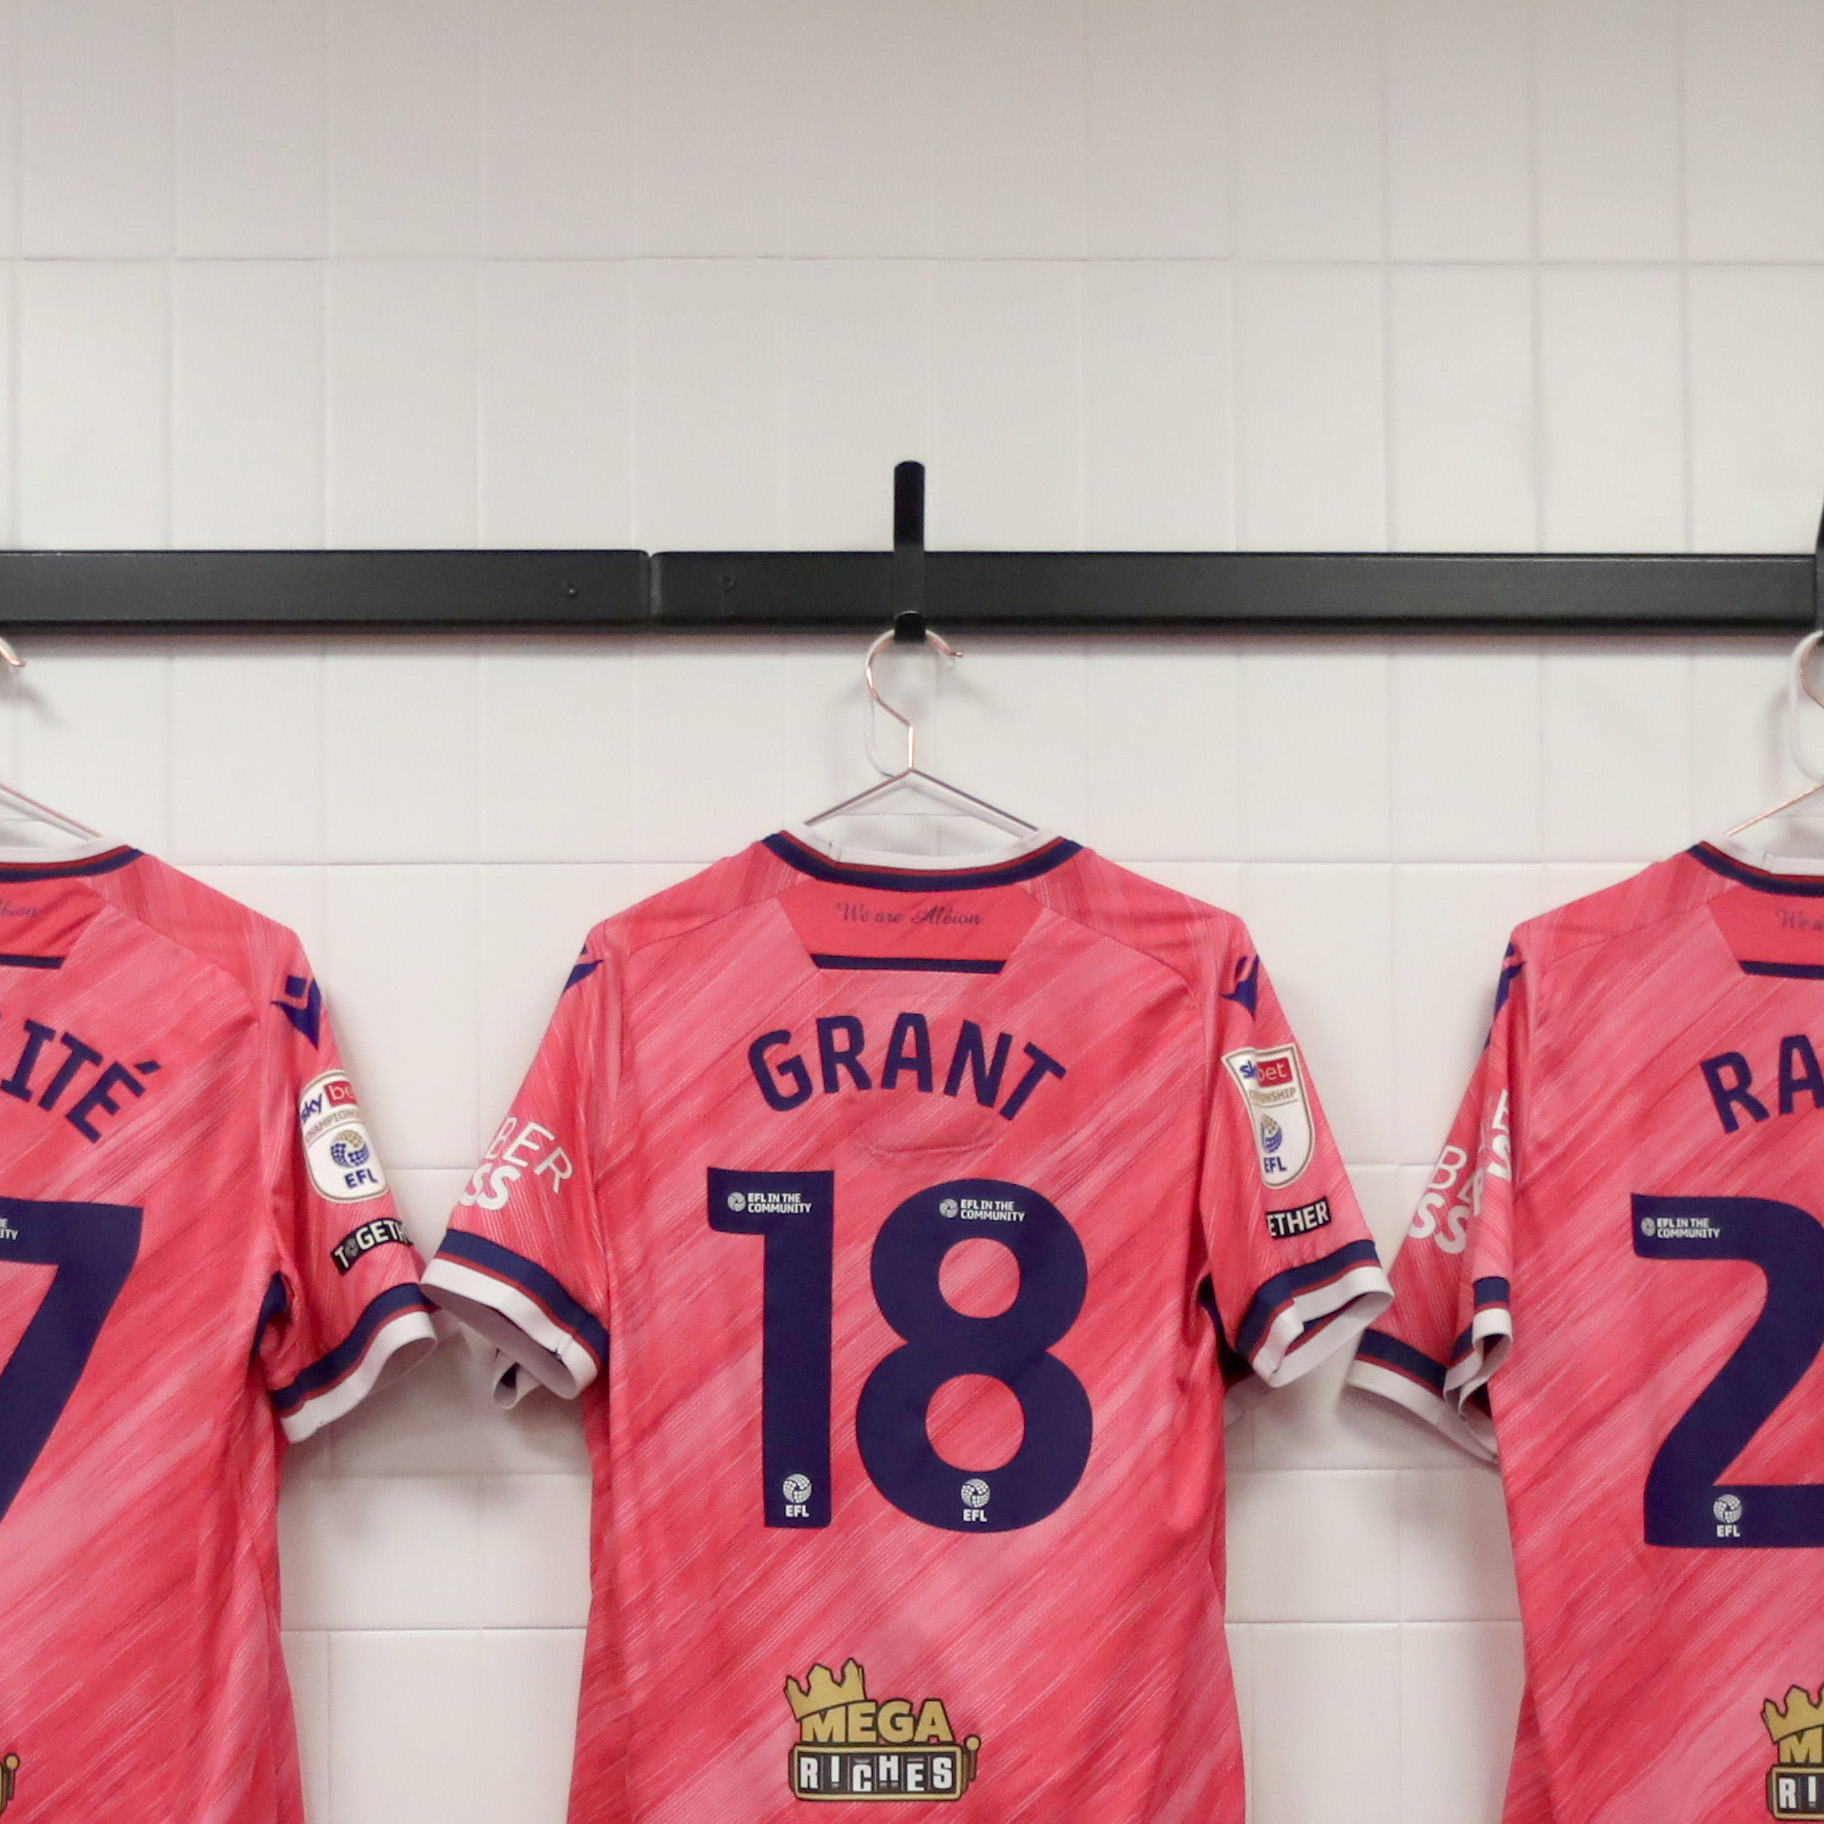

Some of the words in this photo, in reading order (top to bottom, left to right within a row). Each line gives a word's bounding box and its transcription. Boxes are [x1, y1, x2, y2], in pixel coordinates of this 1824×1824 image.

[836, 901, 870, 923] We
[748, 1012, 1067, 1121] GRANT
[1263, 1156, 1288, 1174] EFL
[344, 1168, 379, 1190] EFL
[747, 1192, 767, 1203] EFL
[768, 1193, 780, 1203] IN
[781, 1193, 802, 1204] THE
[960, 1198, 979, 1210] EFL
[981, 1200, 993, 1210] IN
[994, 1201, 1015, 1211] THE
[747, 1202, 813, 1213] COMMUNITY
[960, 1208, 1025, 1222] COMMUNITY
[1657, 1217, 1675, 1228] EFL
[1676, 1217, 1689, 1228] IN
[1690, 1217, 1710, 1229] THE
[1657, 1227, 1721, 1239] COMMUNITY
[707, 1167, 1094, 1534] 18
[784, 1504, 810, 1518] EFL
[962, 1509, 988, 1523] EFL
[1716, 1524, 1741, 1538] EFL
[800, 1698, 955, 1744] MEGA
[799, 1755, 953, 1792] RICHES
